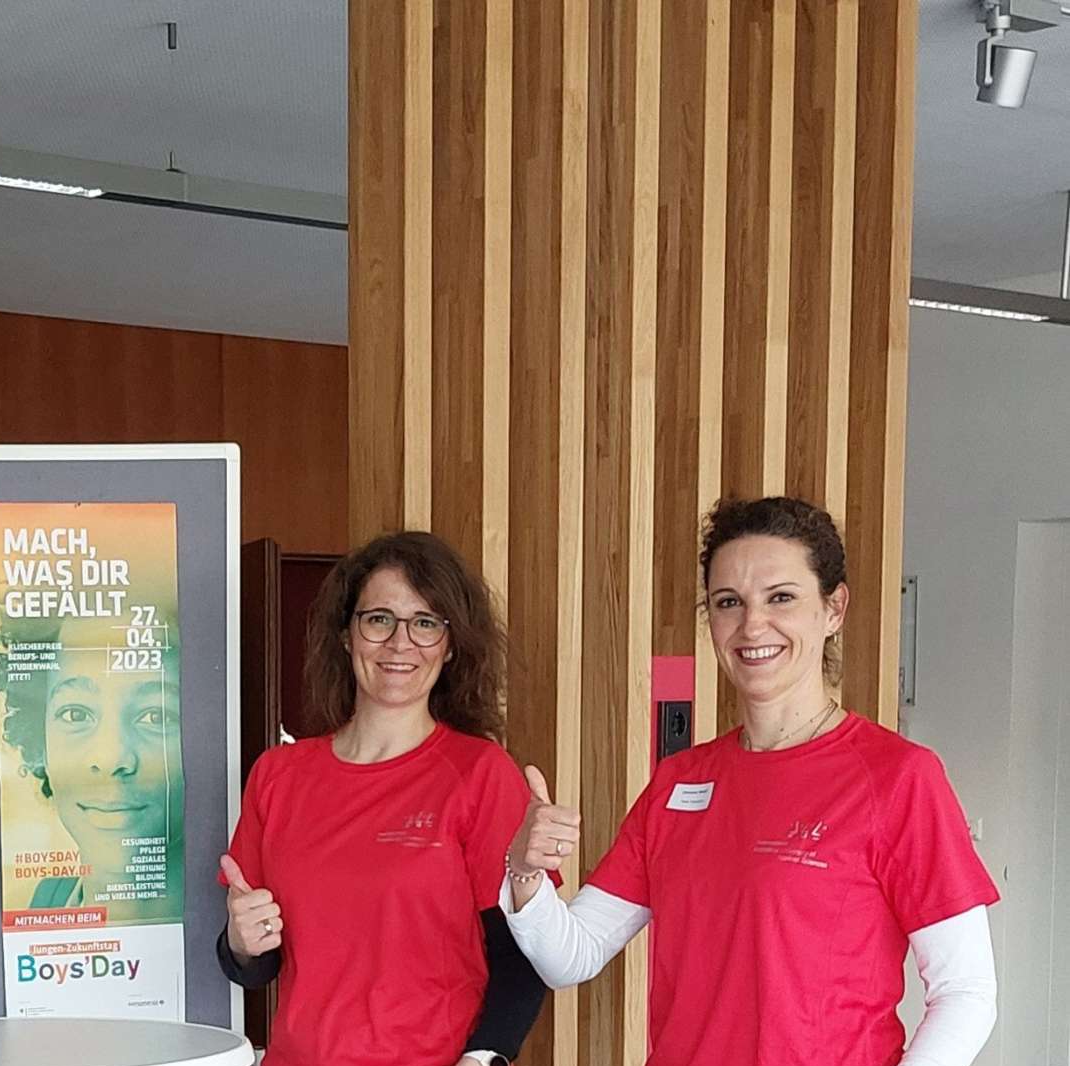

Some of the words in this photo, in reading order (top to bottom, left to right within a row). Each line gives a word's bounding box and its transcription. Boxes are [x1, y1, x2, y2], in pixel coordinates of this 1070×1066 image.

[3, 528, 97, 558] MACH,
[3, 560, 73, 586] WAS
[81, 560, 130, 586] DIR
[5, 586, 127, 618] GEFÄLLT
[130, 606, 159, 626] 27.
[126, 628, 162, 648] 04.
[40, 652, 56, 660] UND
[111, 650, 162, 671] 2023
[7, 662, 60, 670] STUDIENWAHL
[15, 851, 80, 864] #BOYSDAY
[131, 854, 166, 864] SOZIALES
[15, 865, 93, 879] BOYS-DAY.DE
[15, 914, 76, 926] MITMACHEN
[77, 912, 101, 923] BEIM
[31, 941, 118, 954] Jungen-Zukunftstag
[17, 954, 140, 985] Boys'Day
